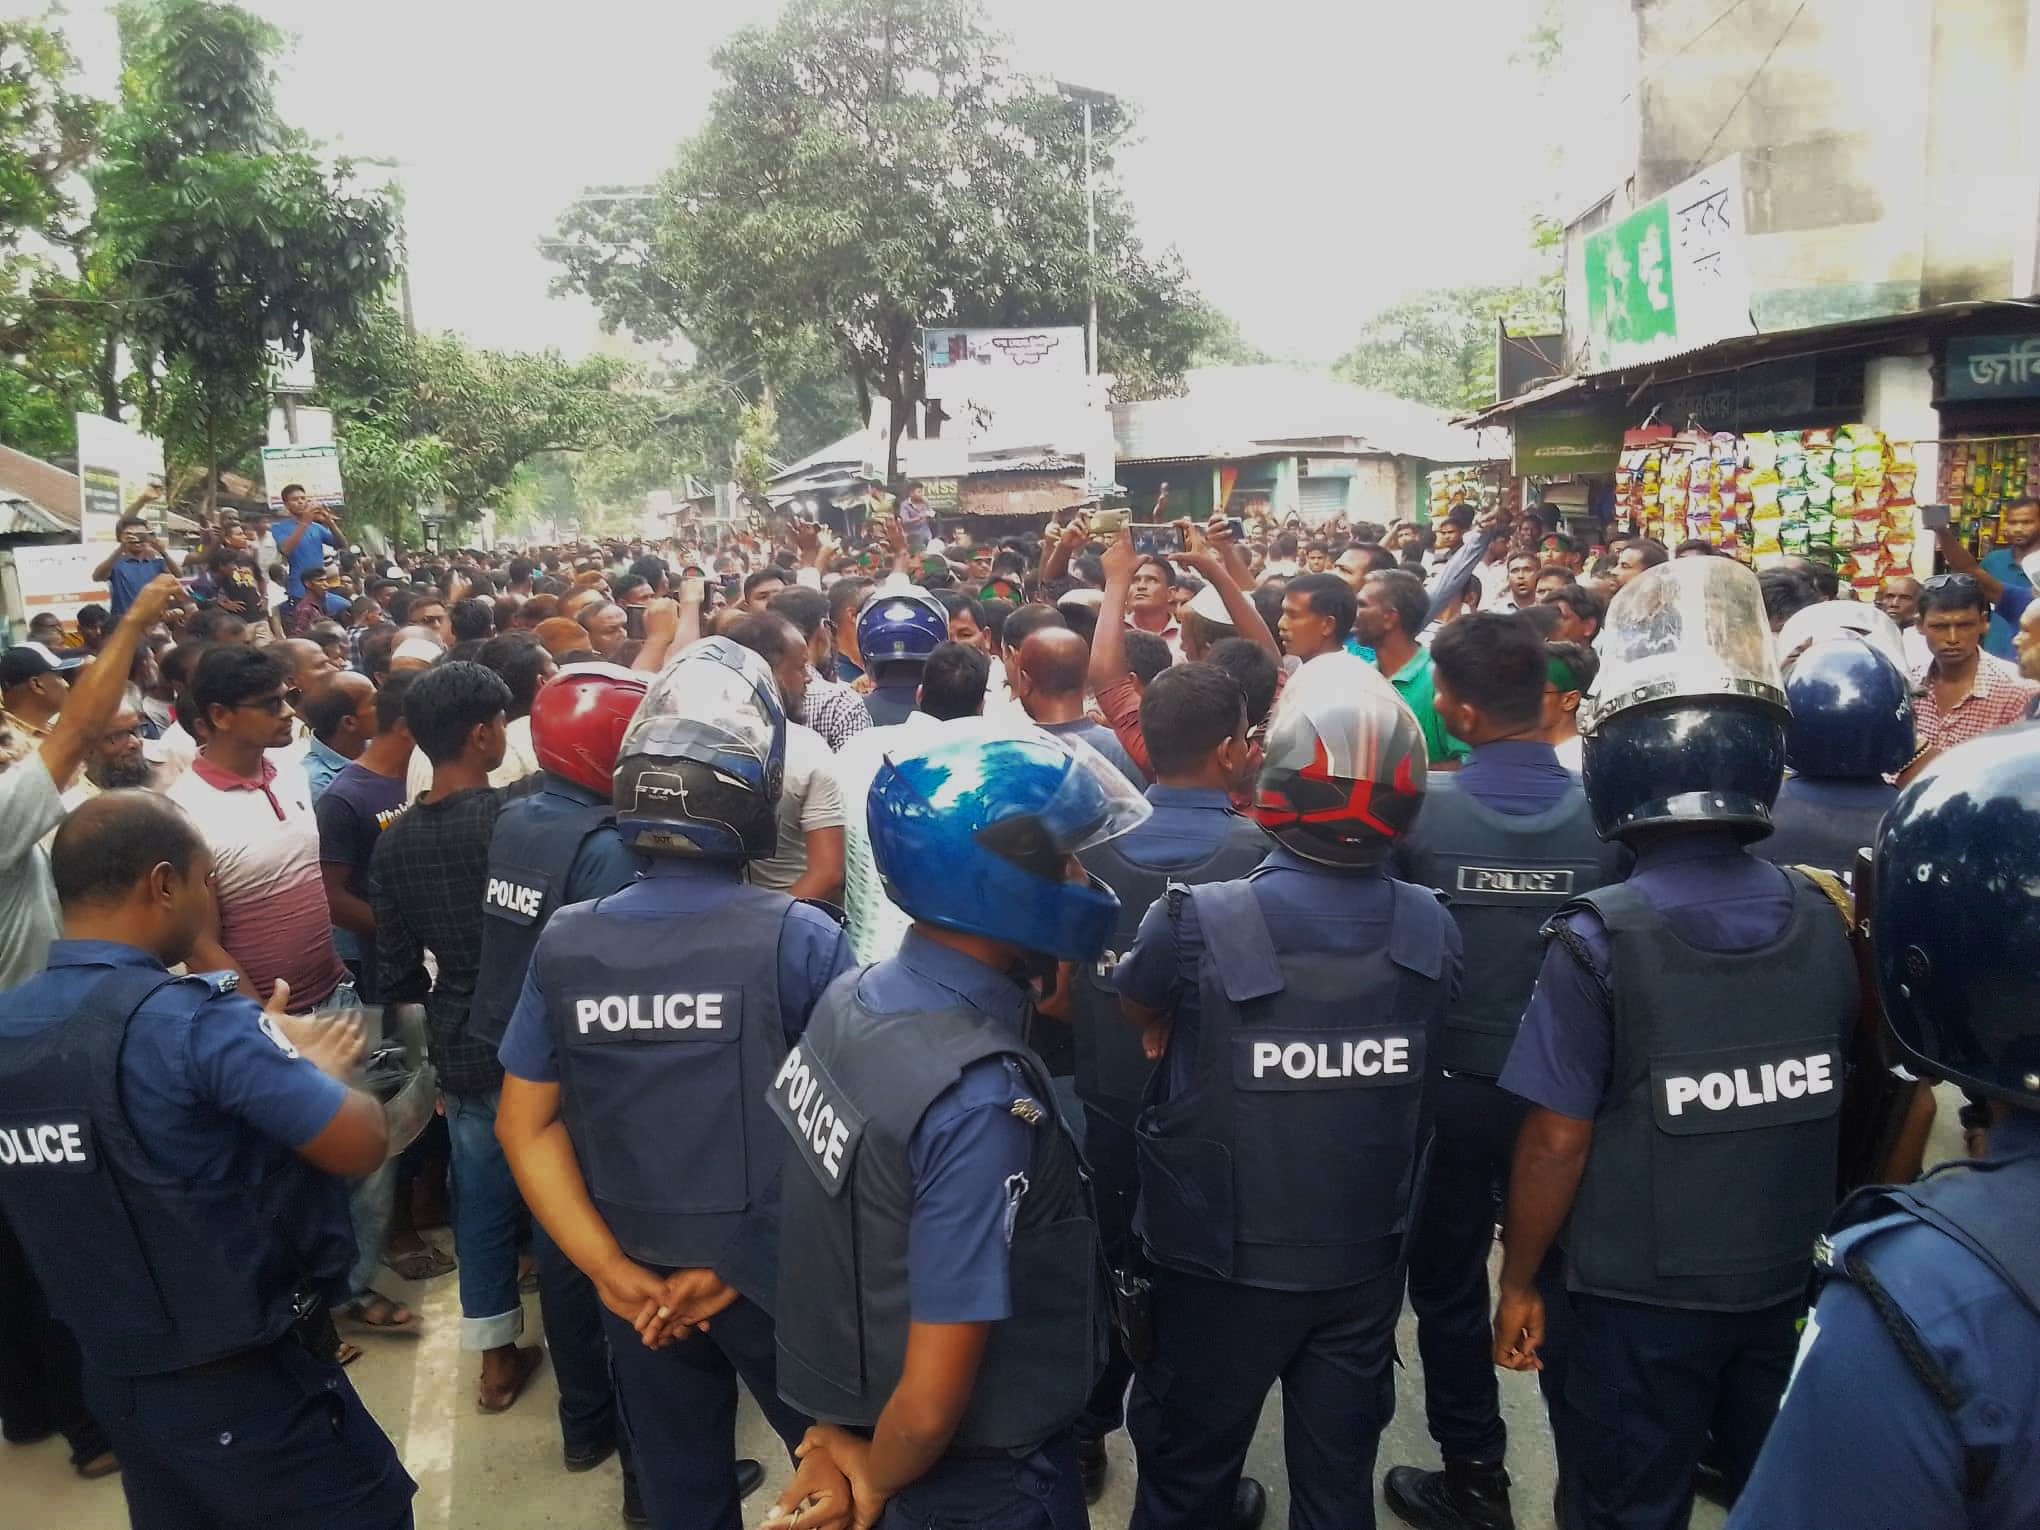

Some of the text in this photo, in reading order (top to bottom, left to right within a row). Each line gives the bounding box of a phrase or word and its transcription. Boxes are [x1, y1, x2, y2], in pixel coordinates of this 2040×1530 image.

[486, 878, 543, 918] POLICE
[1475, 870, 1556, 891] POLICE
[576, 993, 723, 1034] POLICE
[1253, 1038, 1409, 1079] POLICE
[1665, 1053, 1834, 1116] POLICE
[774, 1046, 850, 1179] POLICE
